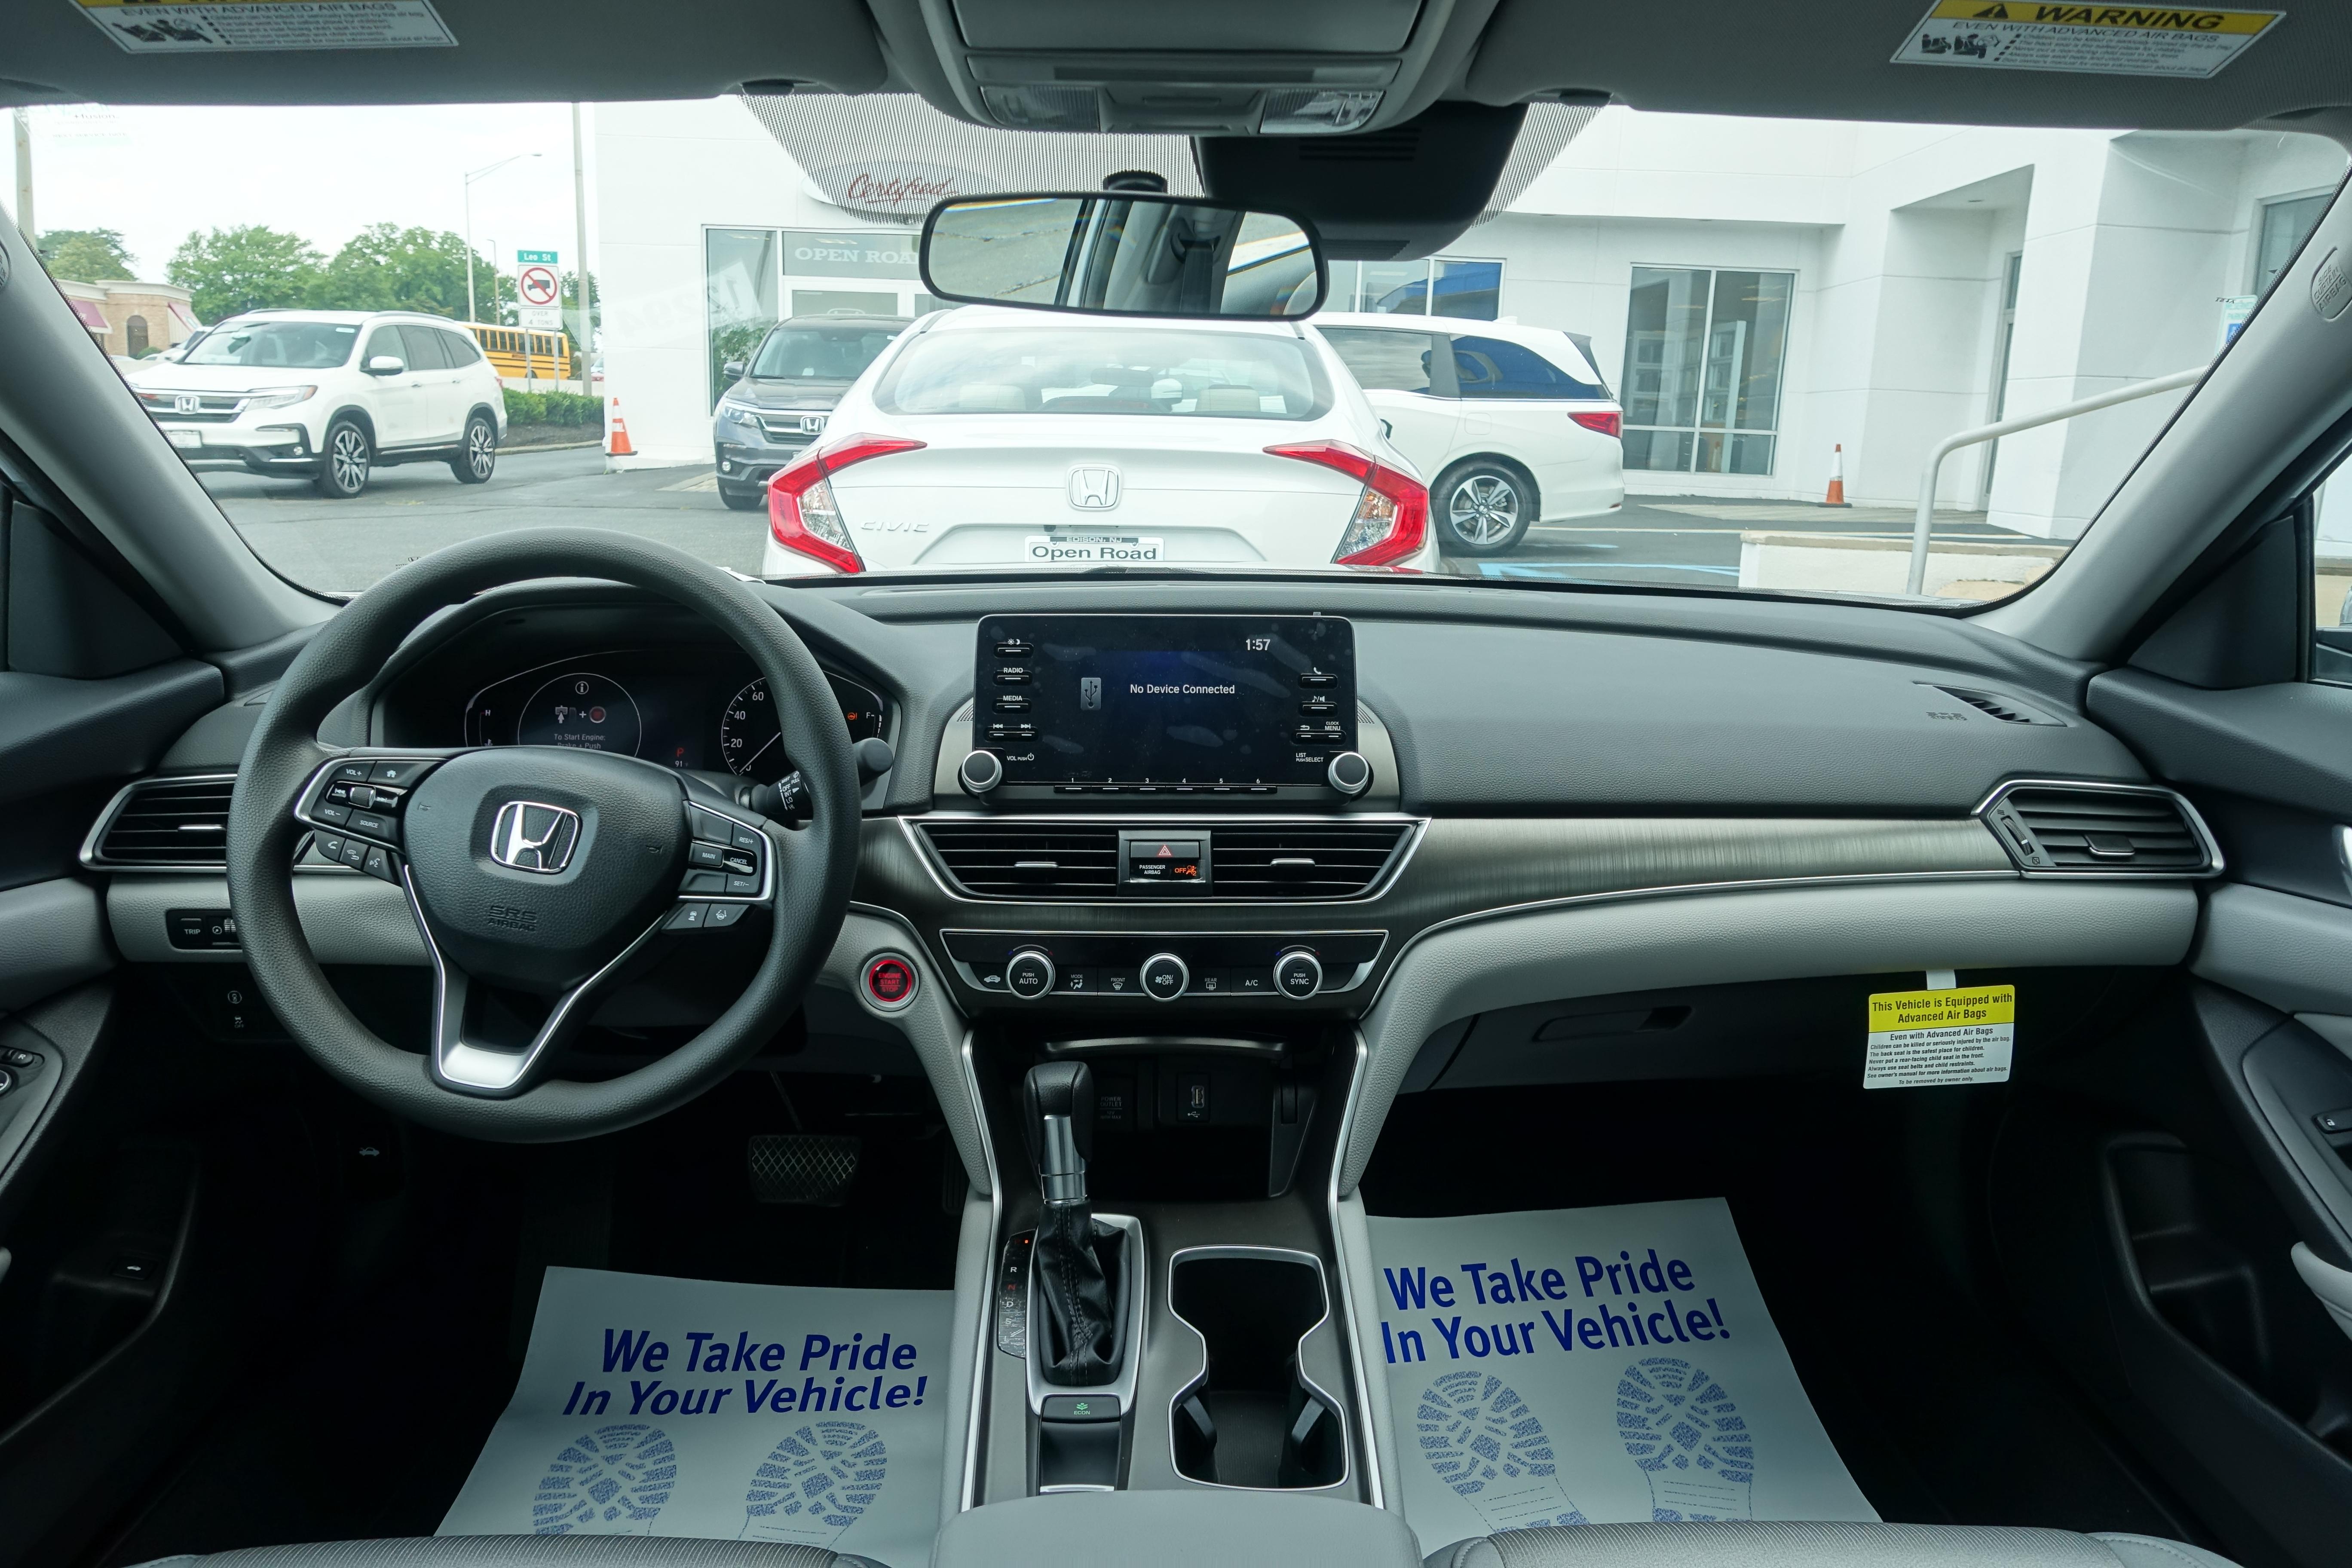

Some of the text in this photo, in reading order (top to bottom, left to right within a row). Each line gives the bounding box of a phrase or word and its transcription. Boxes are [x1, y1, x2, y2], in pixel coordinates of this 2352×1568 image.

[223, 4, 313, 13] ADVANCED
[349, 3, 396, 11] BAGS
[2036, 6, 2224, 29] WARNING
[2003, 24, 2044, 32] WITH
[2045, 27, 2137, 37] ADVANCED
[2171, 33, 2220, 42] BAGS
[794, 247, 859, 263] OPEN
[2318, 264, 2332, 286] SIDE
[2319, 276, 2347, 312] AIRBAG
[861, 521, 929, 533] CIVIC
[1032, 546, 1156, 560] Open Road
[1246, 639, 1270, 651] 1:57
[1130, 684, 1235, 694] No Device Connected
[753, 692, 764, 701] 60
[735, 711, 745, 720] 40
[732, 739, 742, 747] 20
[677, 748, 684, 756] P
[782, 784, 791, 792] OFF
[359, 820, 379, 828] SOURCE
[489, 905, 537, 922] SRS
[1872, 993, 2012, 1011] This Vehicle is Equipped with
[1898, 1010, 1987, 1023] Advanced Air Bags
[1926, 1029, 1961, 1038] Advanced
[1383, 1249, 1695, 1311] We Take Pride
[1381, 1298, 1730, 1363] In Your Vehicle!
[602, 1329, 916, 1372] We Take Pride
[562, 1375, 928, 1415] In Your Vehicle!
